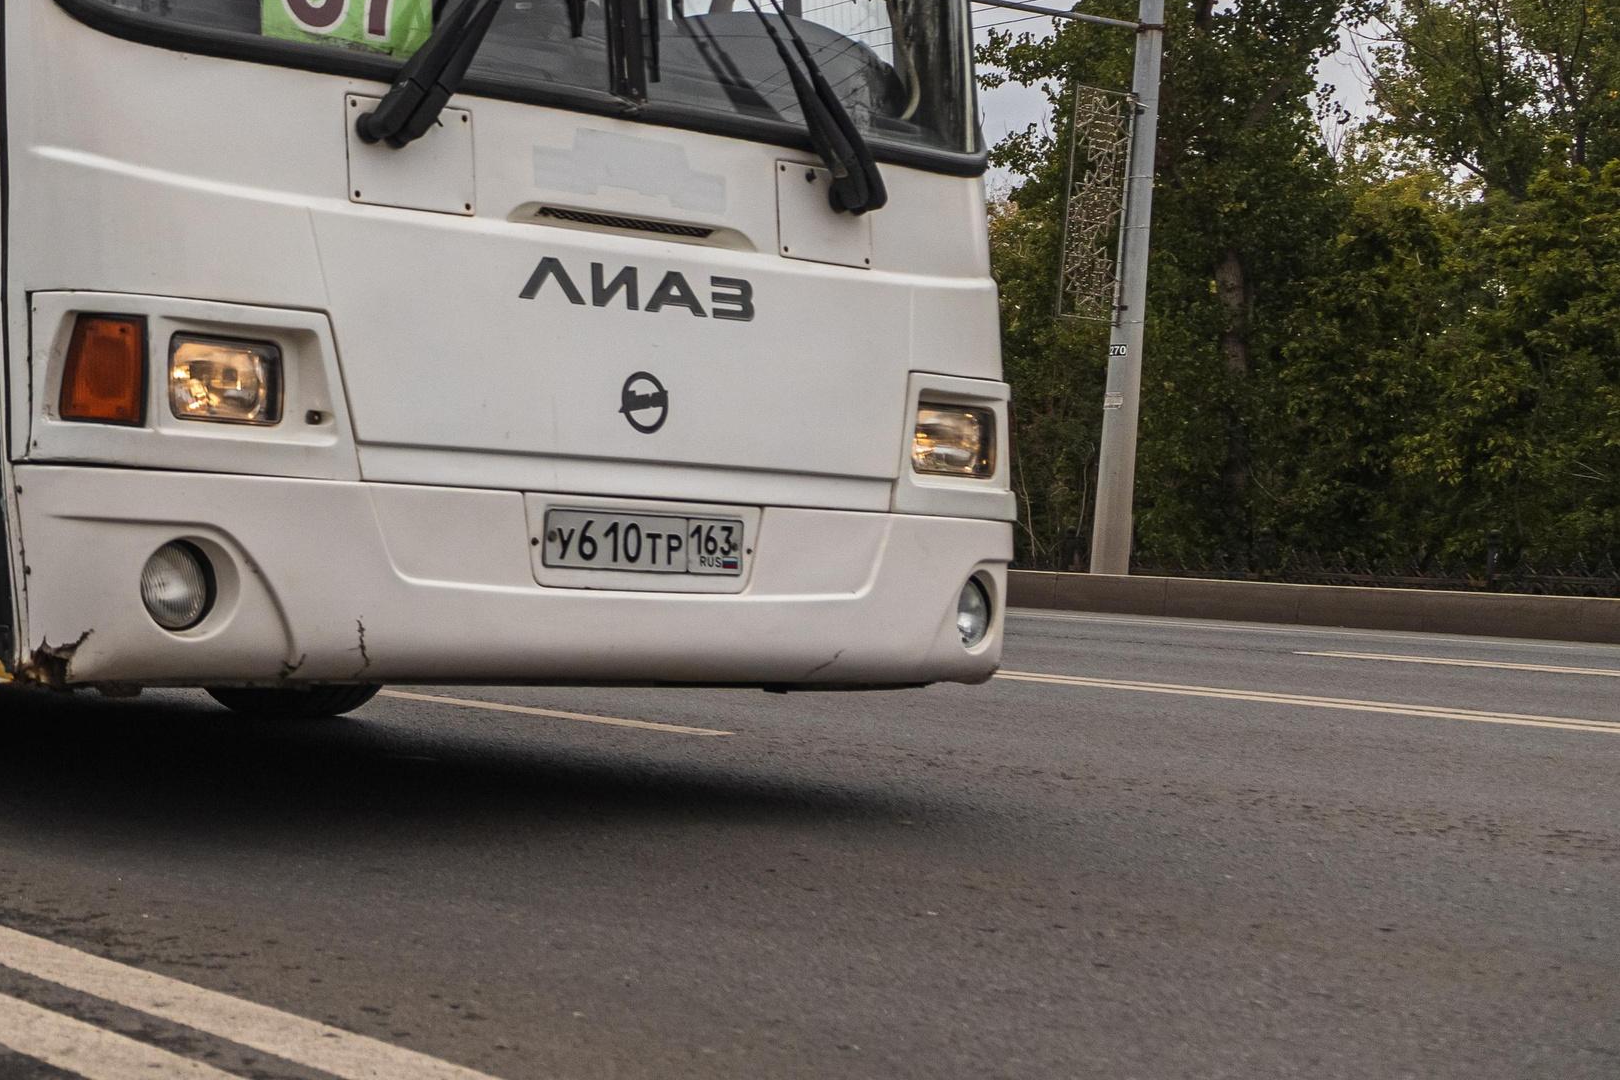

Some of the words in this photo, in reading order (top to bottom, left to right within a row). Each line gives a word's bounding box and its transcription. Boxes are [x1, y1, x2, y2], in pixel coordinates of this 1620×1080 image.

[518, 256, 755, 322] ЛИАЗ
[557, 520, 682, 565] У610ТР
[690, 524, 734, 556] 163
[699, 555, 722, 568] RUS
